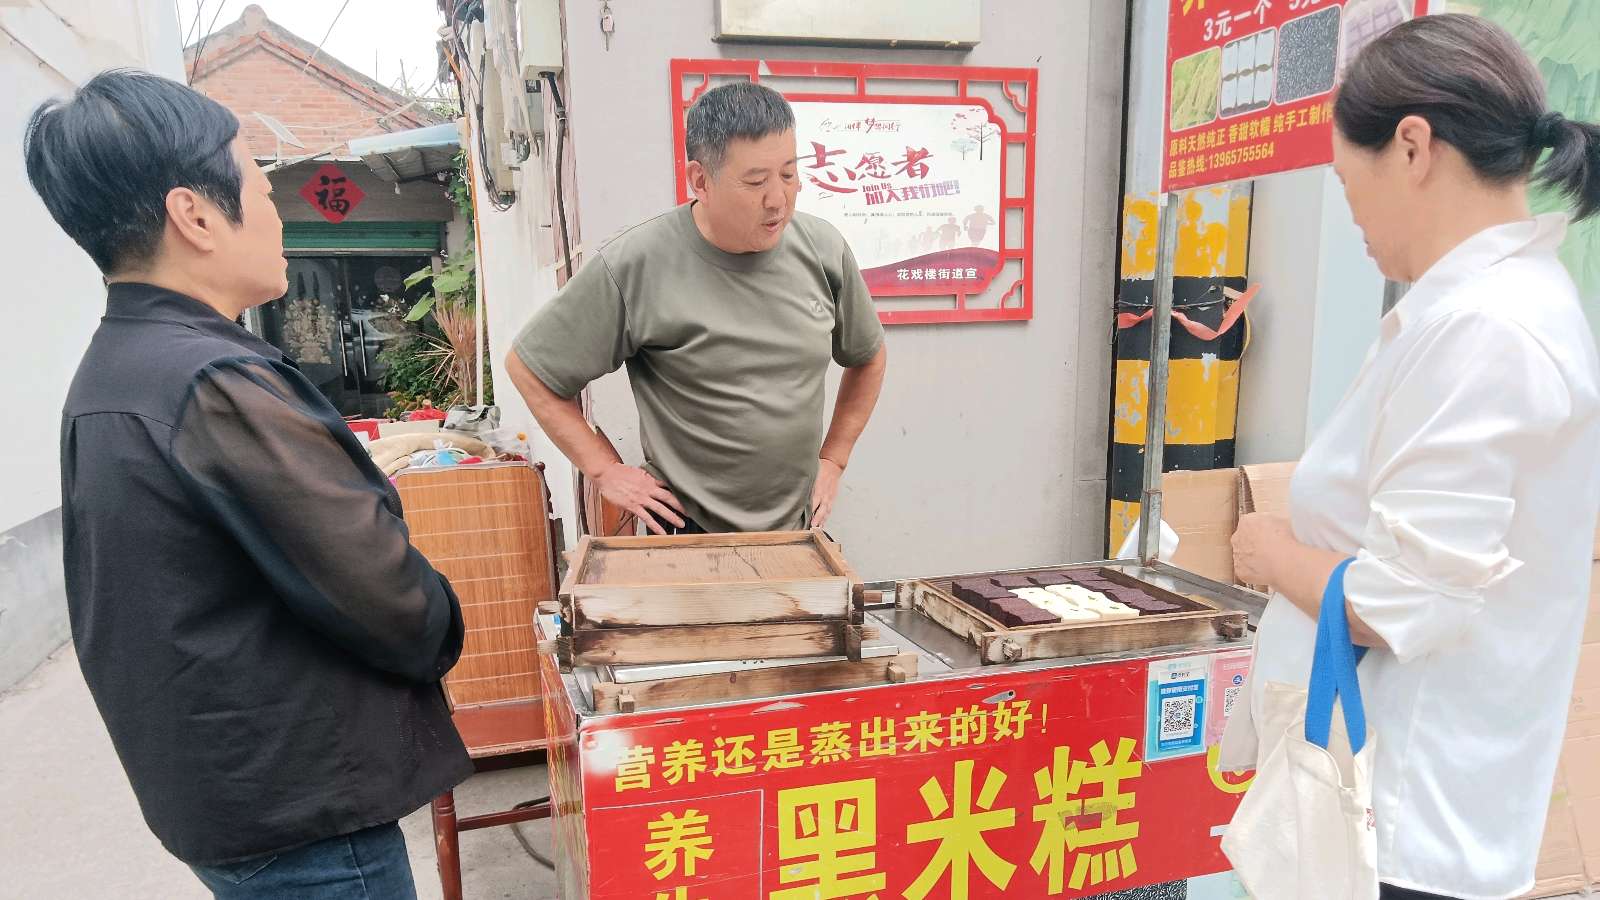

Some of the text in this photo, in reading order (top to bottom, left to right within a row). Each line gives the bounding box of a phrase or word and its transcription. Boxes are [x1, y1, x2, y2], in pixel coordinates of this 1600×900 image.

[1169, 128, 1226, 157] 原料天然纯正
[1229, 118, 1270, 144] 香甜软糯
[797, 141, 934, 194] 志愿者
[315, 176, 350, 216] 福
[897, 268, 977, 280] 花戏楼街道宣
[615, 700, 1048, 792] 营养还是蒸出来的好!
[768, 738, 1143, 900] 黑米糕
